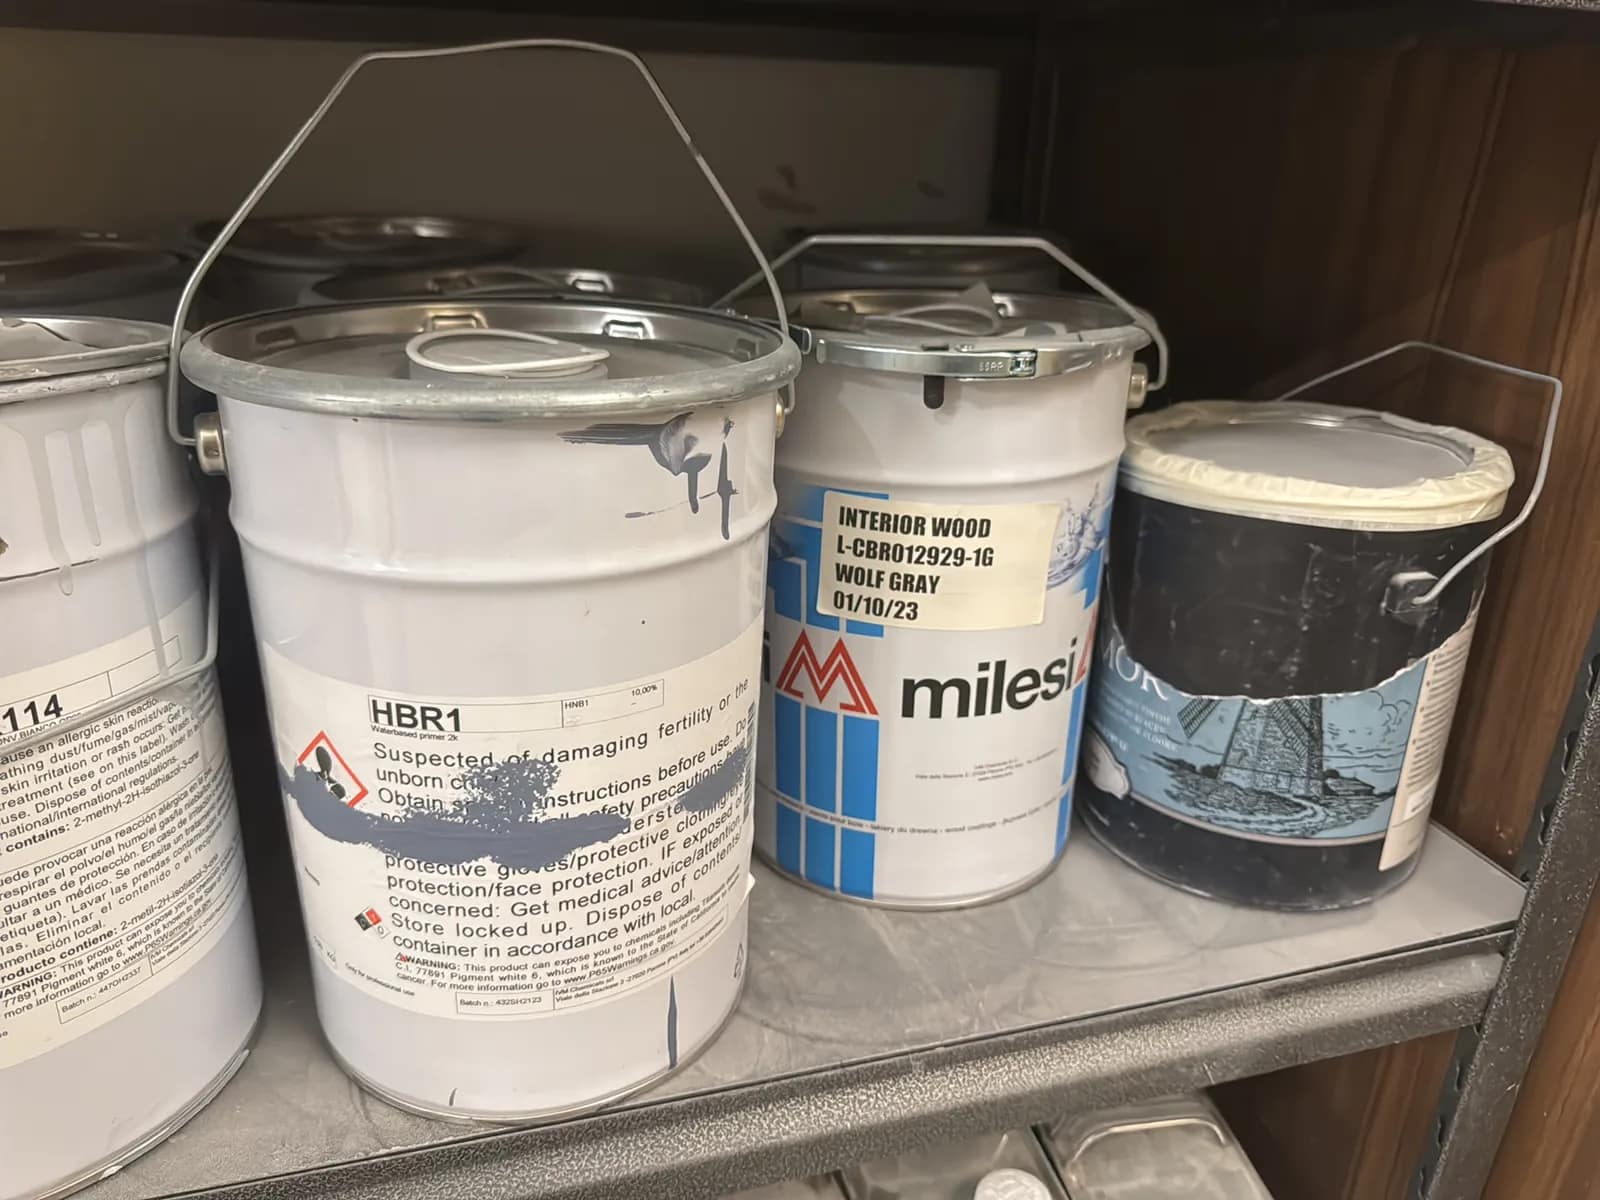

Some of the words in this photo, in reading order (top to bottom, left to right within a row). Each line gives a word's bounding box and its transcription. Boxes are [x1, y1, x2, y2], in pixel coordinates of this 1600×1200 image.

[838, 506, 926, 535] INTERIOR
[931, 517, 992, 538] WOOD
[834, 562, 884, 589] WOLF
[888, 571, 941, 595] GRAY
[833, 589, 919, 621] 01/10/23
[901, 636, 1077, 719] milesi
[0, 694, 63, 735] 114
[372, 699, 460, 732] HBR1
[374, 743, 493, 768] Suspected
[542, 732, 648, 764] damaging
[658, 705, 713, 739] fertility
[719, 693, 731, 711] or
[735, 678, 748, 699] the
[564, 699, 589, 709] HNB1
[38, 742, 54, 754] an
[58, 723, 101, 747] allergic
[103, 711, 124, 729] skin
[1, 779, 29, 795] skin
[34, 757, 87, 784] irritation
[91, 752, 103, 763] or
[107, 739, 130, 757] rash
[68, 769, 95, 788] (see
[100, 762, 114, 773] on
[117, 750, 136, 765] this
[377, 767, 443, 789] unborn
[378, 787, 443, 810] Obtain
[544, 774, 651, 808] nstructions
[658, 751, 705, 781] before
[710, 735, 732, 756] use.
[735, 718, 746, 737] Do
[1, 810, 30, 825] use.
[35, 788, 87, 813] Dispose
[91, 779, 103, 791] of
[6, 824, 70, 852] contains:
[33, 846, 88, 876] provocar
[91, 835, 112, 850] una
[115, 811, 156, 840] reacción
[54, 868, 66, 880] el
[70, 846, 116, 876] polvo/el
[118, 824, 157, 852] humo/el
[387, 875, 542, 897] protection/face
[552, 857, 653, 895] protection.
[661, 841, 677, 860] IF
[683, 802, 733, 848] exposed
[3, 887, 57, 914] guantes
[60, 879, 76, 891] de
[79, 849, 139, 885] protección.
[141, 839, 155, 852] En
[157, 826, 176, 843] caso
[32, 907, 41, 917] a
[45, 899, 61, 911] un
[65, 879, 112, 903] médico.
[115, 867, 130, 879] Se
[134, 841, 171, 870] necesita
[173, 833, 183, 844] un
[71, 893, 106, 914] Lavar
[110, 883, 128, 896] las
[132, 856, 170, 887] prendas
[385, 854, 487, 876] protective
[36, 911, 94, 942] Eliminar
[100, 902, 112, 914] el
[118, 869, 171, 905] contenido
[174, 862, 181, 870] o
[184, 851, 192, 863] el
[389, 895, 499, 918] concerned:
[511, 900, 555, 916] Get
[558, 879, 634, 912] medical
[391, 912, 444, 935] Store
[456, 922, 528, 938] locked
[541, 920, 573, 936] up.
[586, 889, 663, 926] Dispose
[671, 873, 687, 894] of
[60, 927, 118, 959] contiene:
[61, 959, 83, 974] This
[87, 939, 124, 964] product
[126, 929, 142, 941] can
[144, 909, 173, 932] expose
[174, 899, 187, 914] you
[74, 919, 106, 940] local.
[393, 934, 478, 957] container
[484, 943, 500, 957] in
[507, 927, 618, 957] accordance
[623, 911, 656, 934] with
[660, 888, 696, 918] local.
[3, 989, 37, 1008] 77891
[41, 968, 86, 993] Pigment
[88, 955, 114, 972] white
[127, 932, 152, 952] which
[154, 927, 161, 936] is
[162, 911, 185, 930] known
[450, 971, 494, 982] Pigment
[498, 971, 527, 981] white
[546, 965, 577, 977] which
[580, 963, 590, 971] is
[593, 953, 624, 967] known
[627, 947, 637, 955] to
[640, 940, 654, 952] the
[657, 927, 678, 943] State
[464, 963, 486, 972] This
[490, 963, 528, 973] product
[532, 961, 551, 969] can
[554, 953, 590, 966] expose
[593, 948, 610, 959] you
[625, 924, 667, 947] chemicals
[4, 1003, 33, 1019] more
[36, 976, 94, 1007] information
[96, 969, 110, 980] go
[111, 961, 121, 972] to
[61, 998, 85, 1013] Batch
[431, 979, 447, 988] For
[449, 981, 474, 991] more
[477, 981, 533, 991] information
[535, 980, 549, 990] go
[551, 978, 562, 986] to
